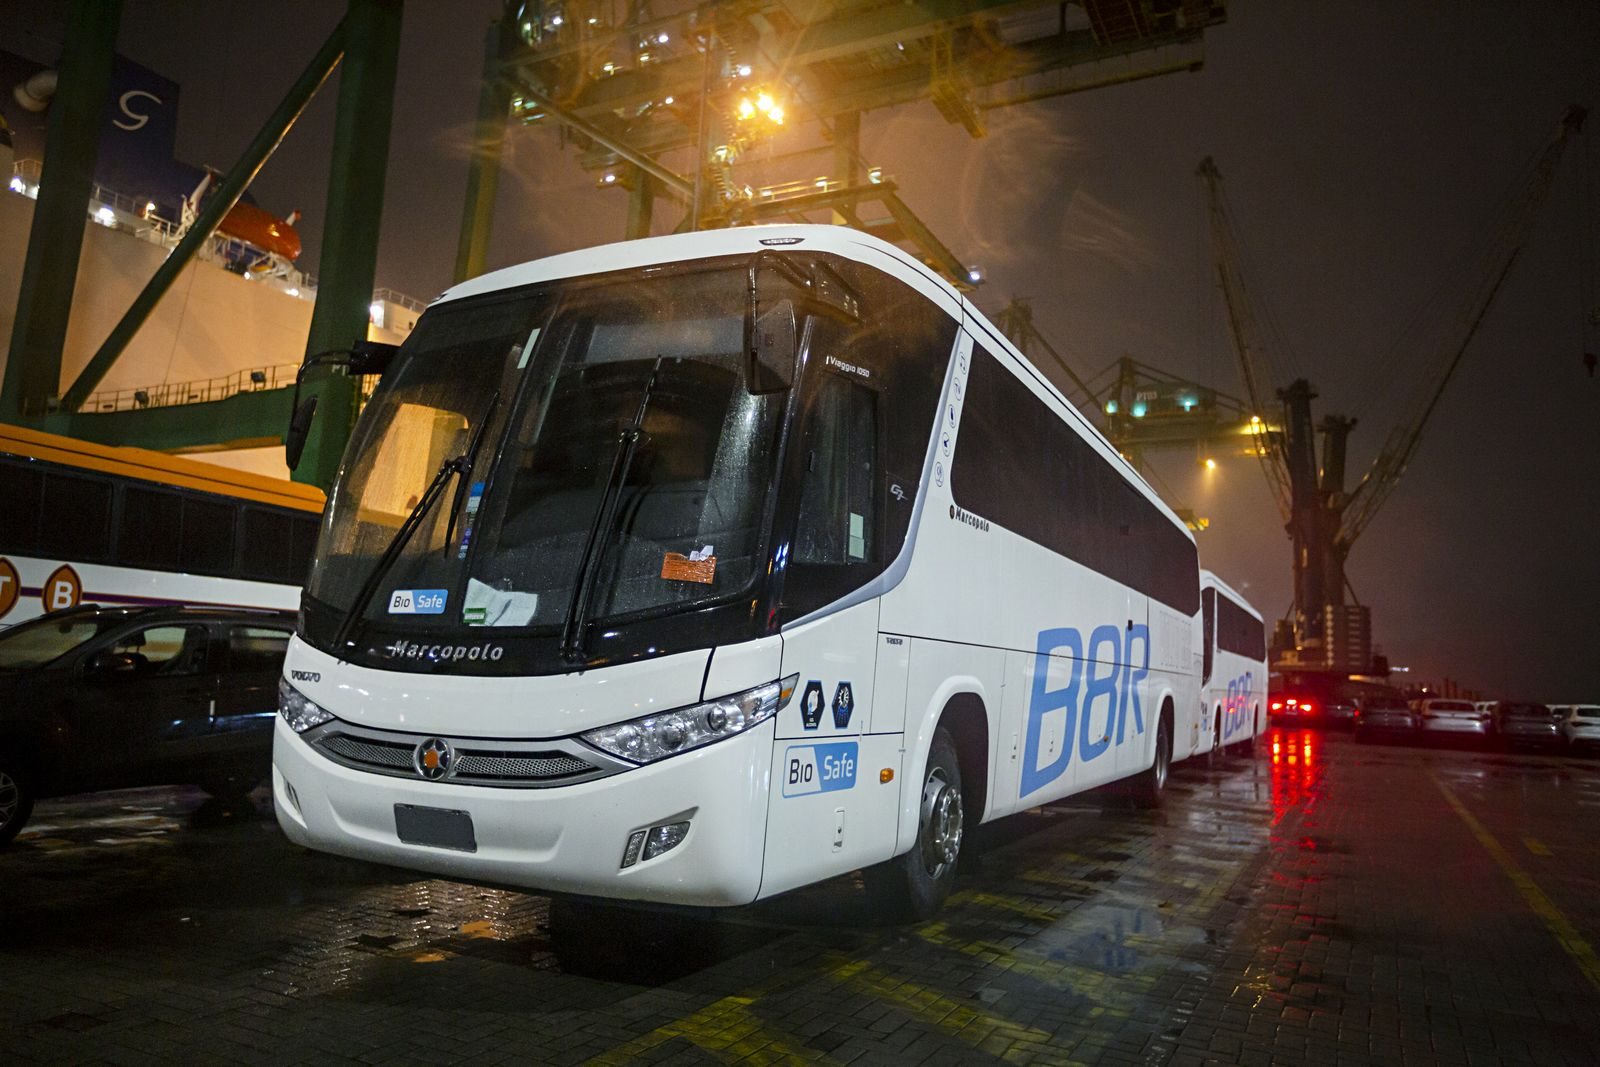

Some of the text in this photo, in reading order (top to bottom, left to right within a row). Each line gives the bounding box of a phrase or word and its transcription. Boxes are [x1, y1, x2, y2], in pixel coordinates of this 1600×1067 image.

[830, 355, 856, 373] Viaggio
[955, 506, 990, 533] Marcopolo
[52, 581, 73, 609] B
[416, 595, 443, 608] Safe
[391, 640, 504, 661] Marcopolo
[291, 669, 321, 683] VOLVO
[1019, 624, 1149, 799] B8R
[823, 751, 854, 781] Safe
